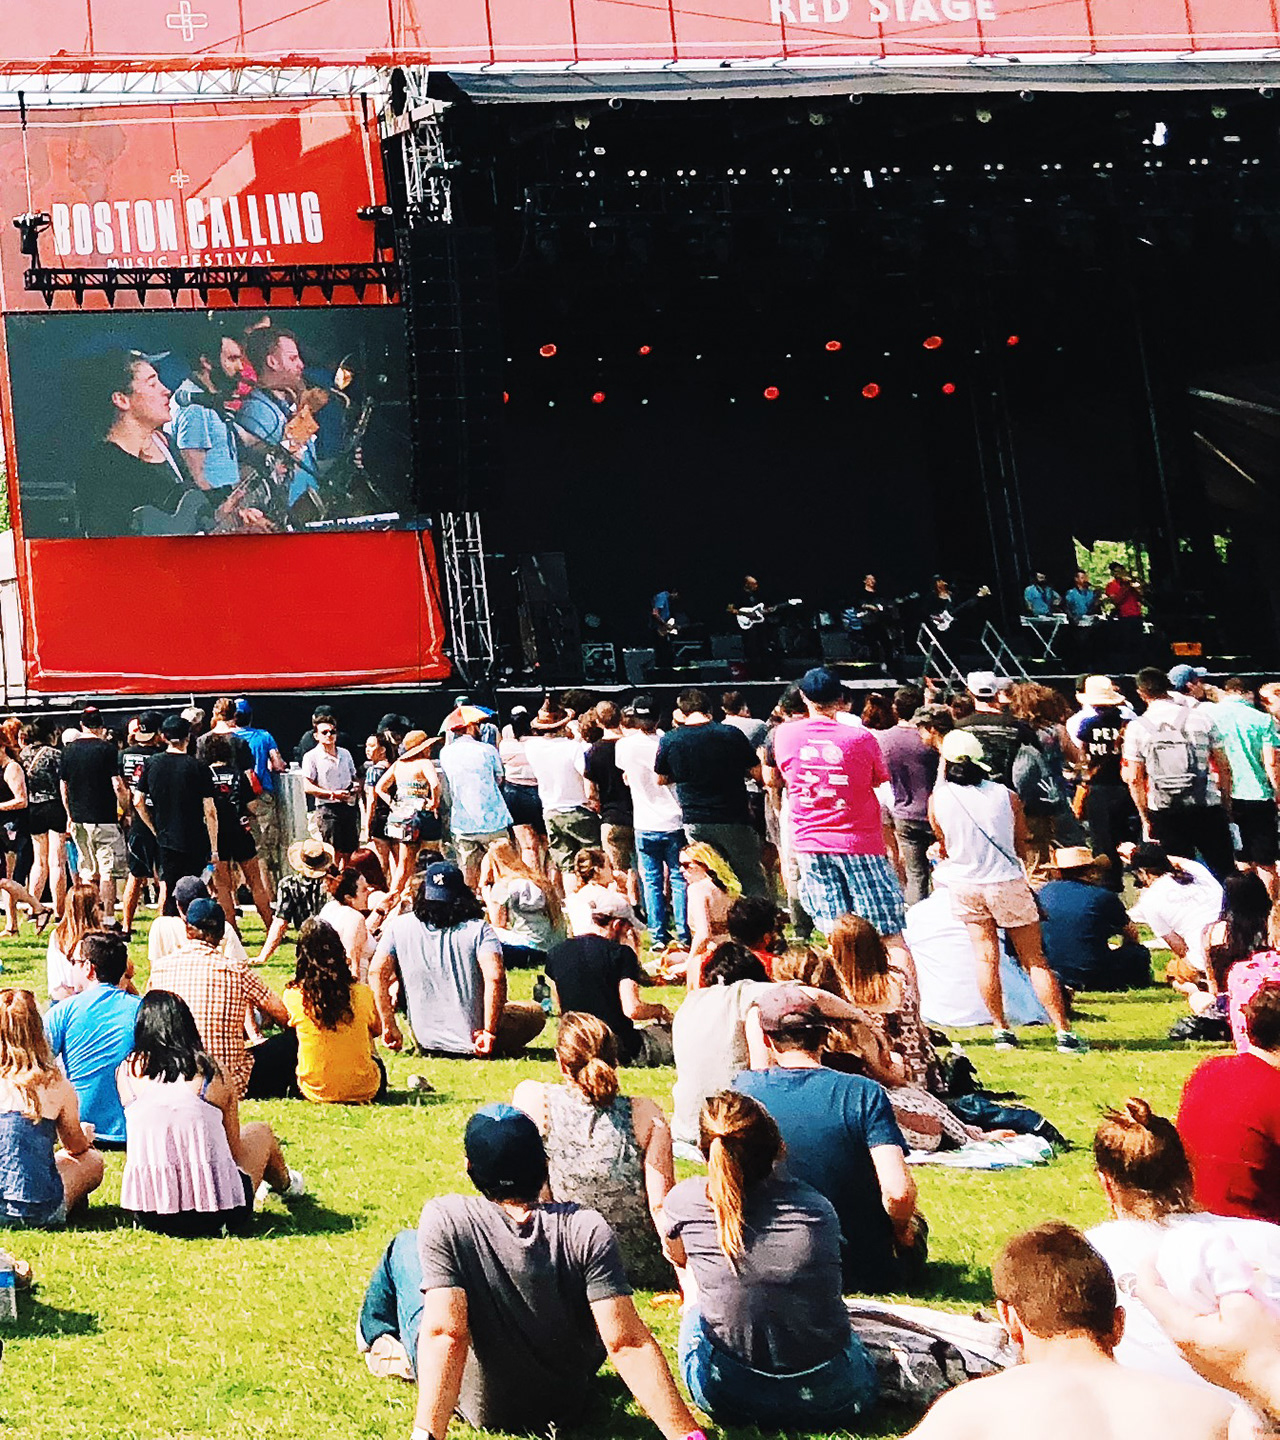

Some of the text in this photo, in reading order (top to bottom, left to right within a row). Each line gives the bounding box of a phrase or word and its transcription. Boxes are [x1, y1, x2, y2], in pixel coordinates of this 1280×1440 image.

[52, 190, 325, 256] BOSTON CALLING
[106, 250, 276, 269] MUSIC FESTIVAL
